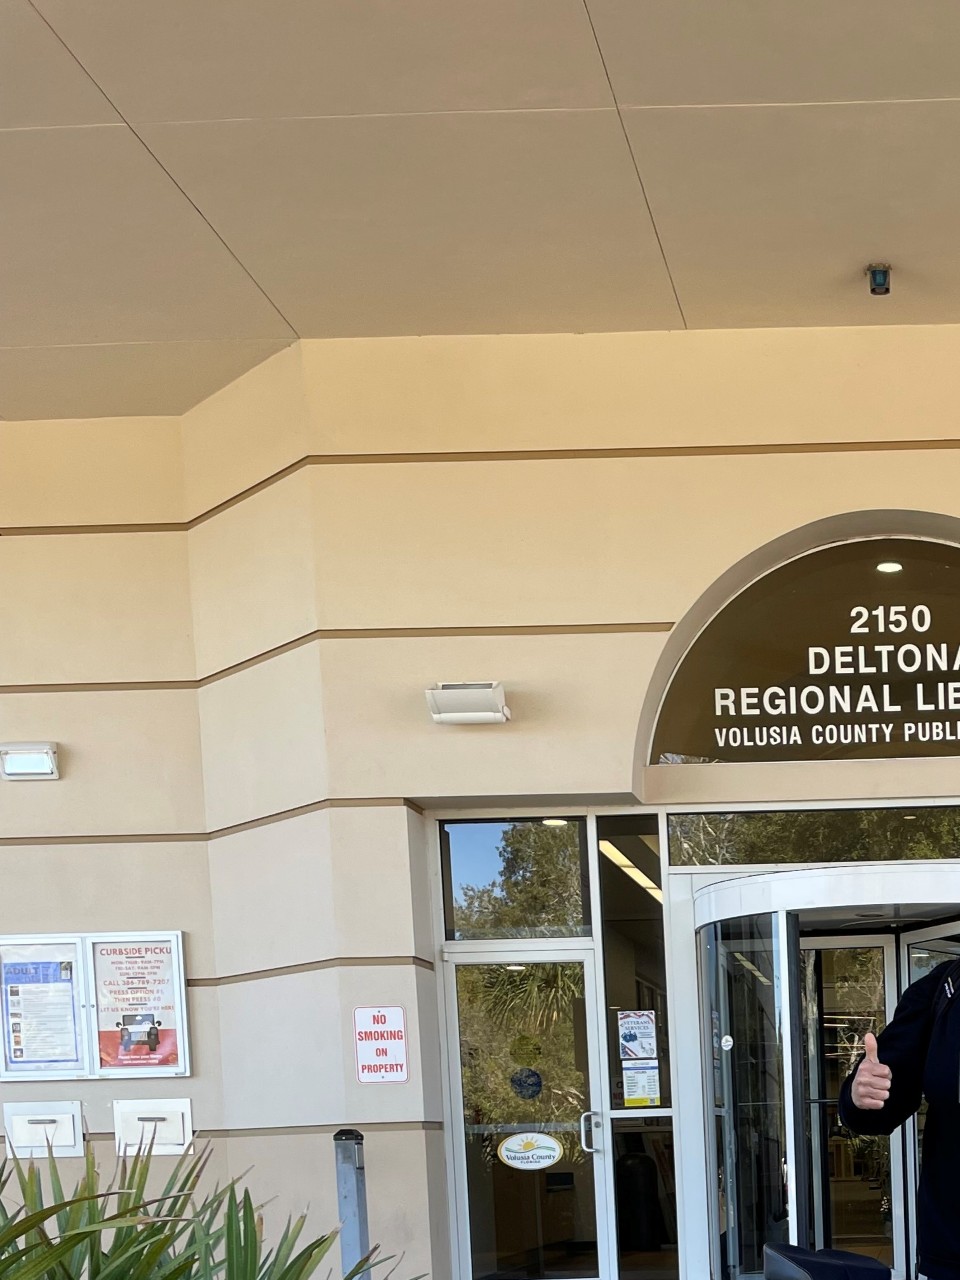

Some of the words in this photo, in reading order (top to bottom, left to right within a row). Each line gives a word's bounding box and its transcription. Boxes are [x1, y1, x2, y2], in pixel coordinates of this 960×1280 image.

[850, 604, 932, 633] 2150
[714, 684, 902, 716] REGIONAL
[714, 725, 803, 747] VOLUSIA
[811, 723, 894, 745] COUNTY
[100, 947, 143, 956] CURBSIDE
[372, 1014, 386, 1024] NO
[357, 1030, 403, 1041] SMOKING
[375, 1047, 388, 1057] ON
[361, 1064, 404, 1073] PROPERTY
[531, 1153, 556, 1161] County
